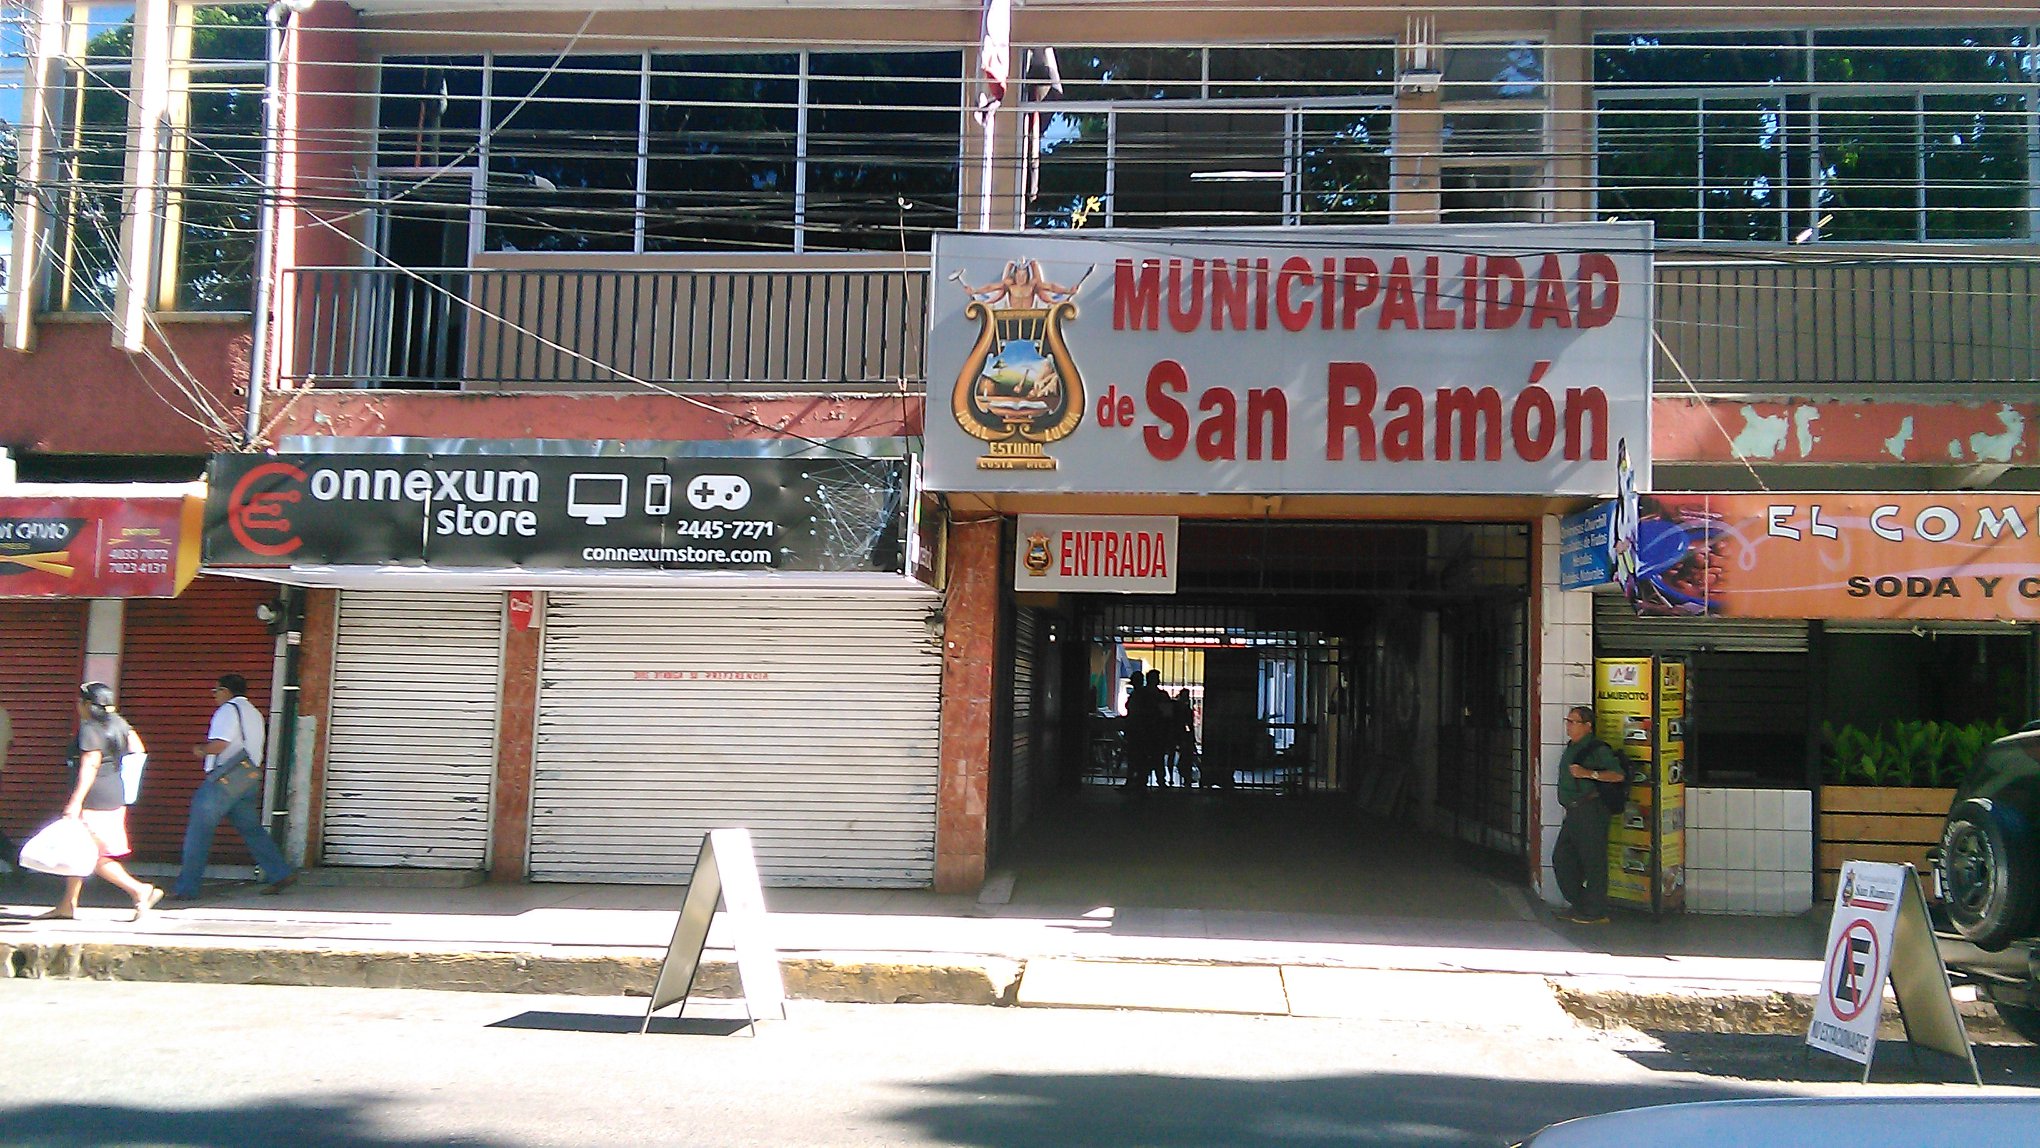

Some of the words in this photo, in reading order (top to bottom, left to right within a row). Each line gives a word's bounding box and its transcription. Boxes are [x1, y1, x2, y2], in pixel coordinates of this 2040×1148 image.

[1113, 253, 1619, 332] MUNICIPALIDAD
[1097, 384, 1135, 428] de
[1142, 359, 1288, 462] San
[1326, 360, 1609, 463] Ramón
[989, 442, 1042, 455] ESTUDIO
[980, 461, 1013, 469] COSTA
[1026, 461, 1052, 469] RICA
[436, 503, 537, 536] store
[677, 519, 774, 540] 2445-7271
[1767, 504, 1838, 540] EL
[1869, 504, 2040, 542] COM
[582, 545, 772, 564] connexumstore.com
[1060, 531, 1168, 577] ENTRADA
[1847, 576, 1961, 598] SODA
[1975, 577, 2002, 597] Y
[1598, 690, 1649, 701] ALMUERCITOS
